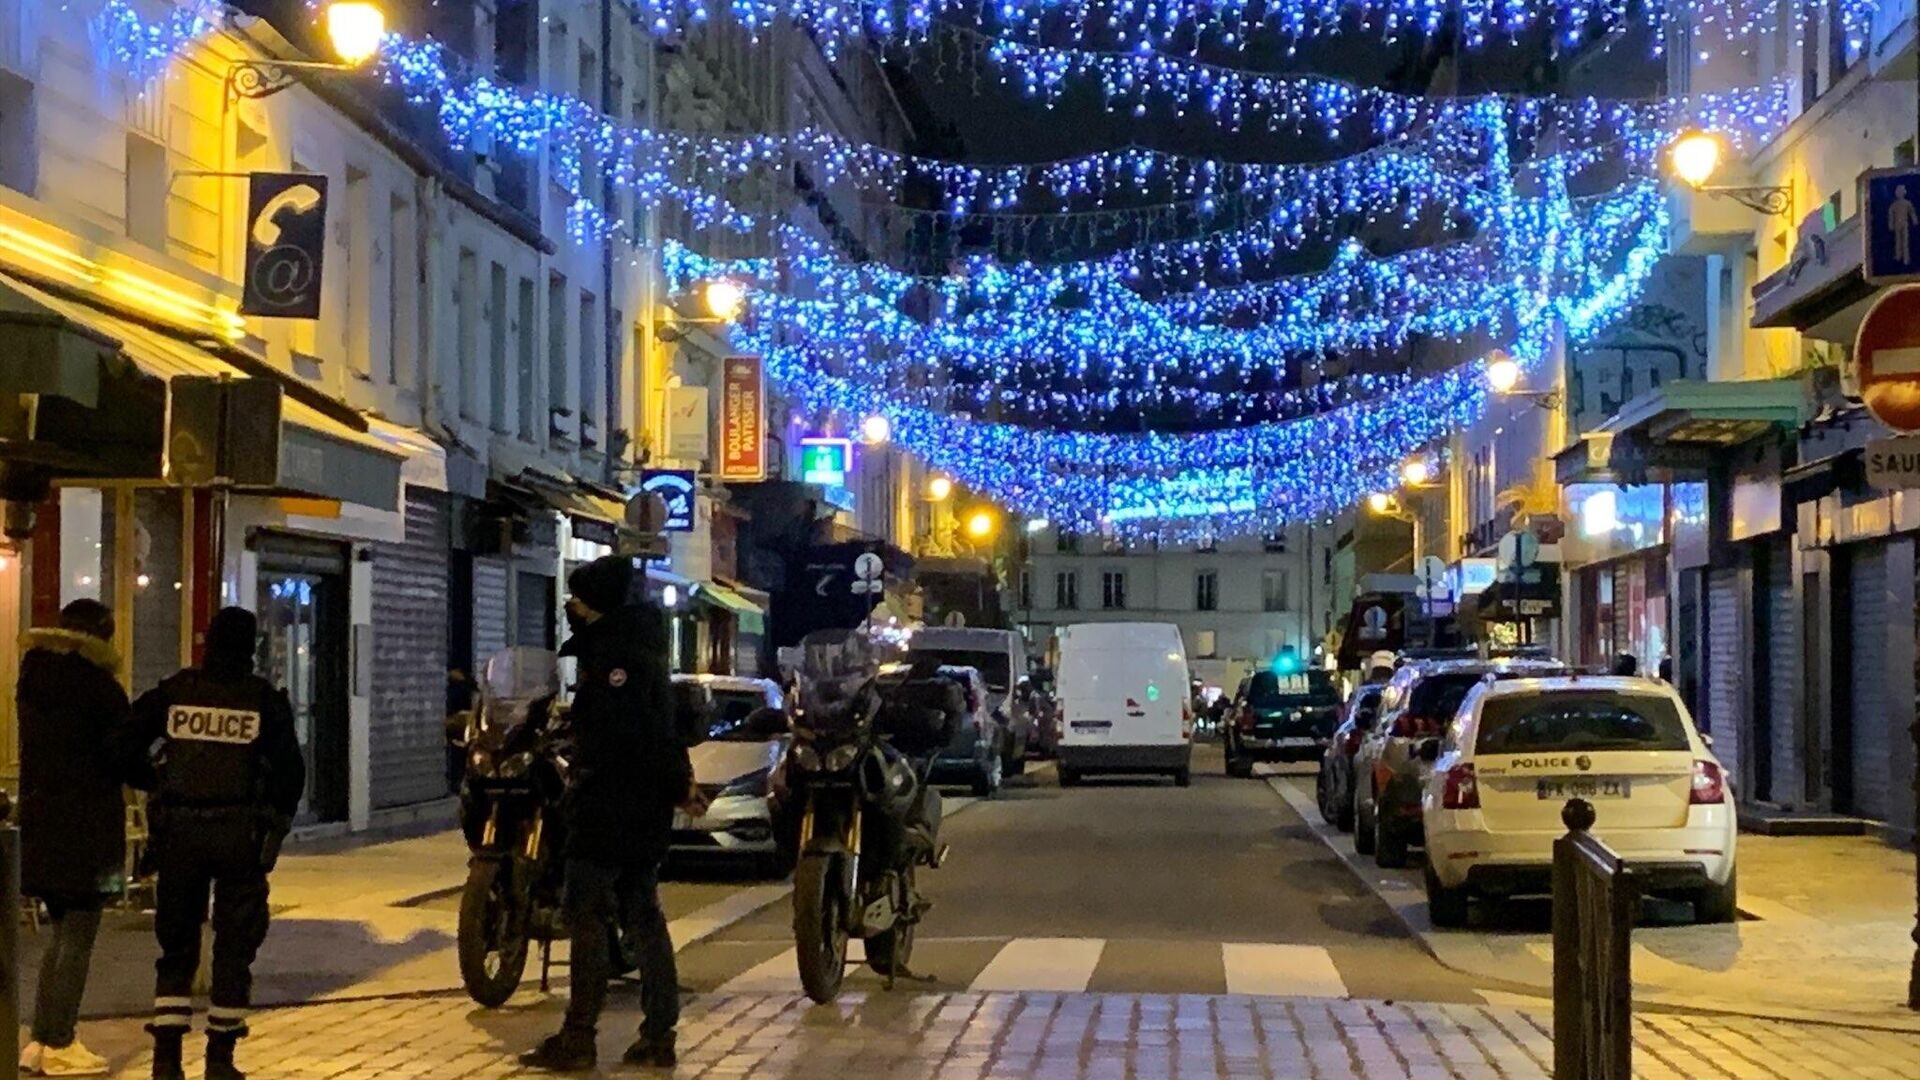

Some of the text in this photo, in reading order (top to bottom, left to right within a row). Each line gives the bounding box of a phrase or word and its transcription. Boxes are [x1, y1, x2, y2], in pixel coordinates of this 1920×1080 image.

[729, 382, 741, 460] BOULANGER
[1871, 453, 1920, 473] SAU
[172, 709, 255, 739] POLICE
[1511, 756, 1570, 769] POLICE
